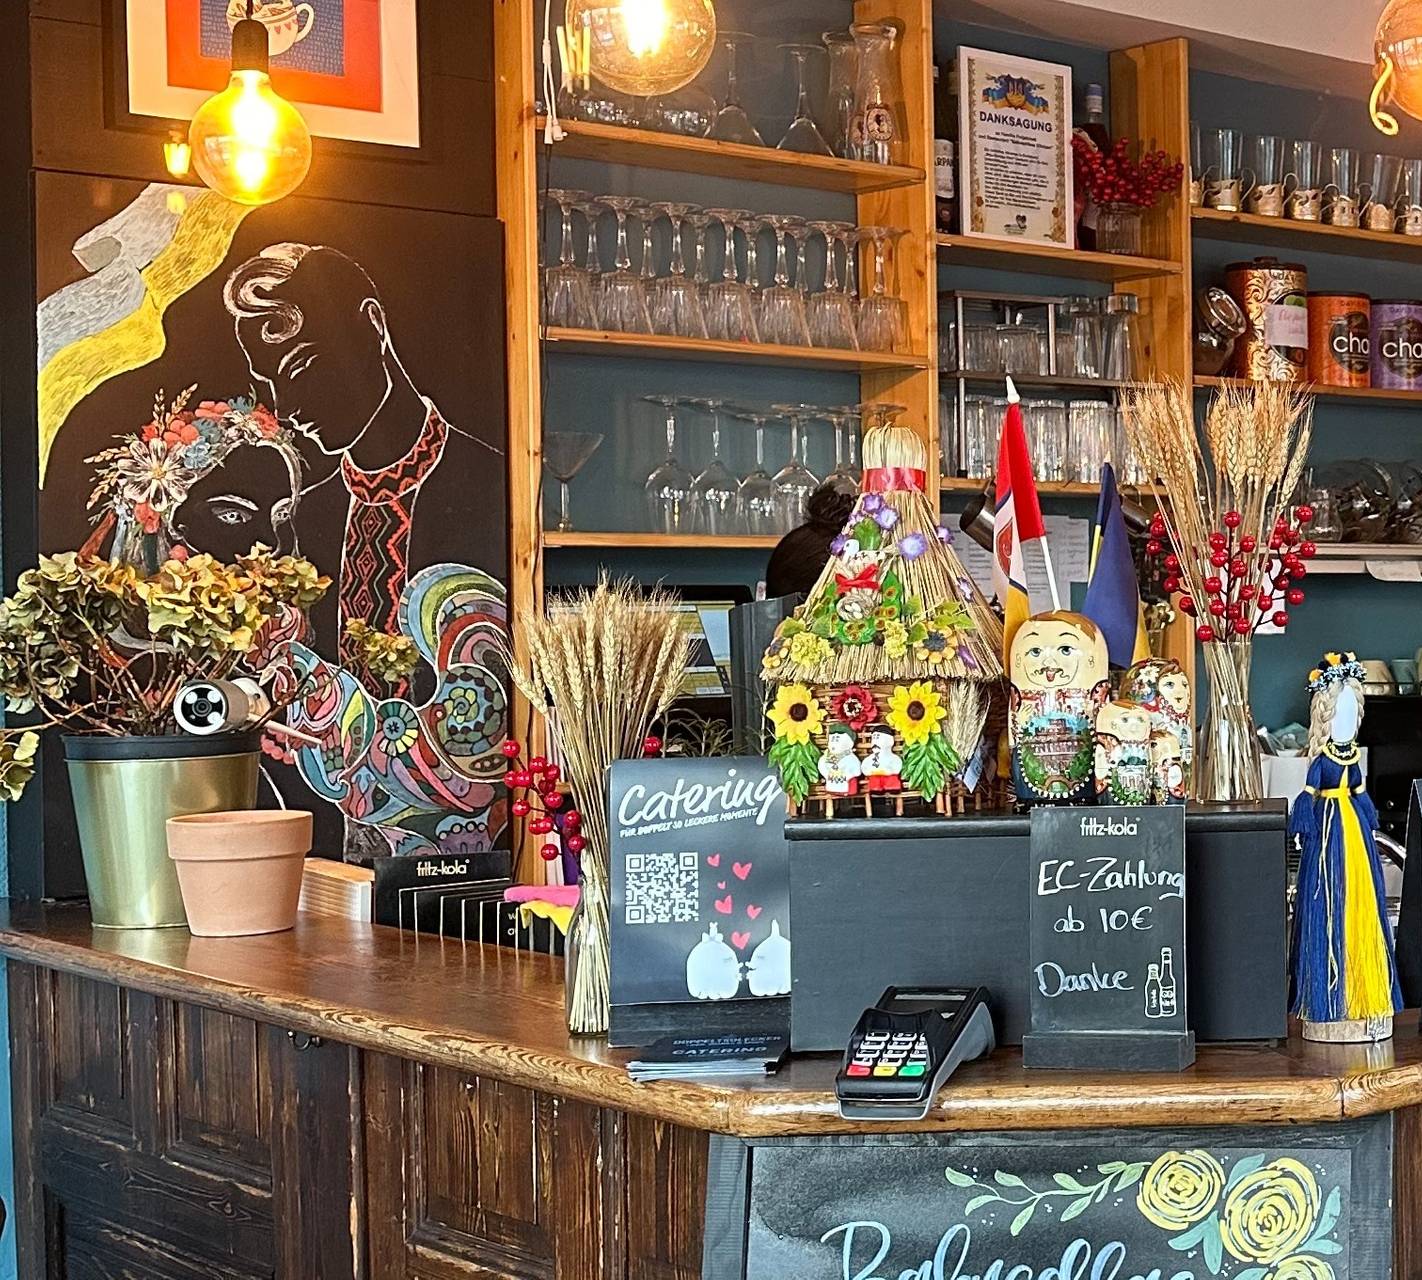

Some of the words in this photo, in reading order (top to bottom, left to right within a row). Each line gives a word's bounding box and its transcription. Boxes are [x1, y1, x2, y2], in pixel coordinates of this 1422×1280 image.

[979, 111, 1053, 133] DANKSAGUNG
[1333, 330, 1369, 355] cha
[618, 768, 782, 826] Catering
[1079, 816, 1138, 837] fritz-kola
[416, 859, 468, 877] fritz-kola
[1037, 856, 1185, 901] EC-Zahlung
[1053, 904, 1085, 933] ab
[1099, 905, 1153, 933] 10€
[1033, 961, 1135, 998] Danke
